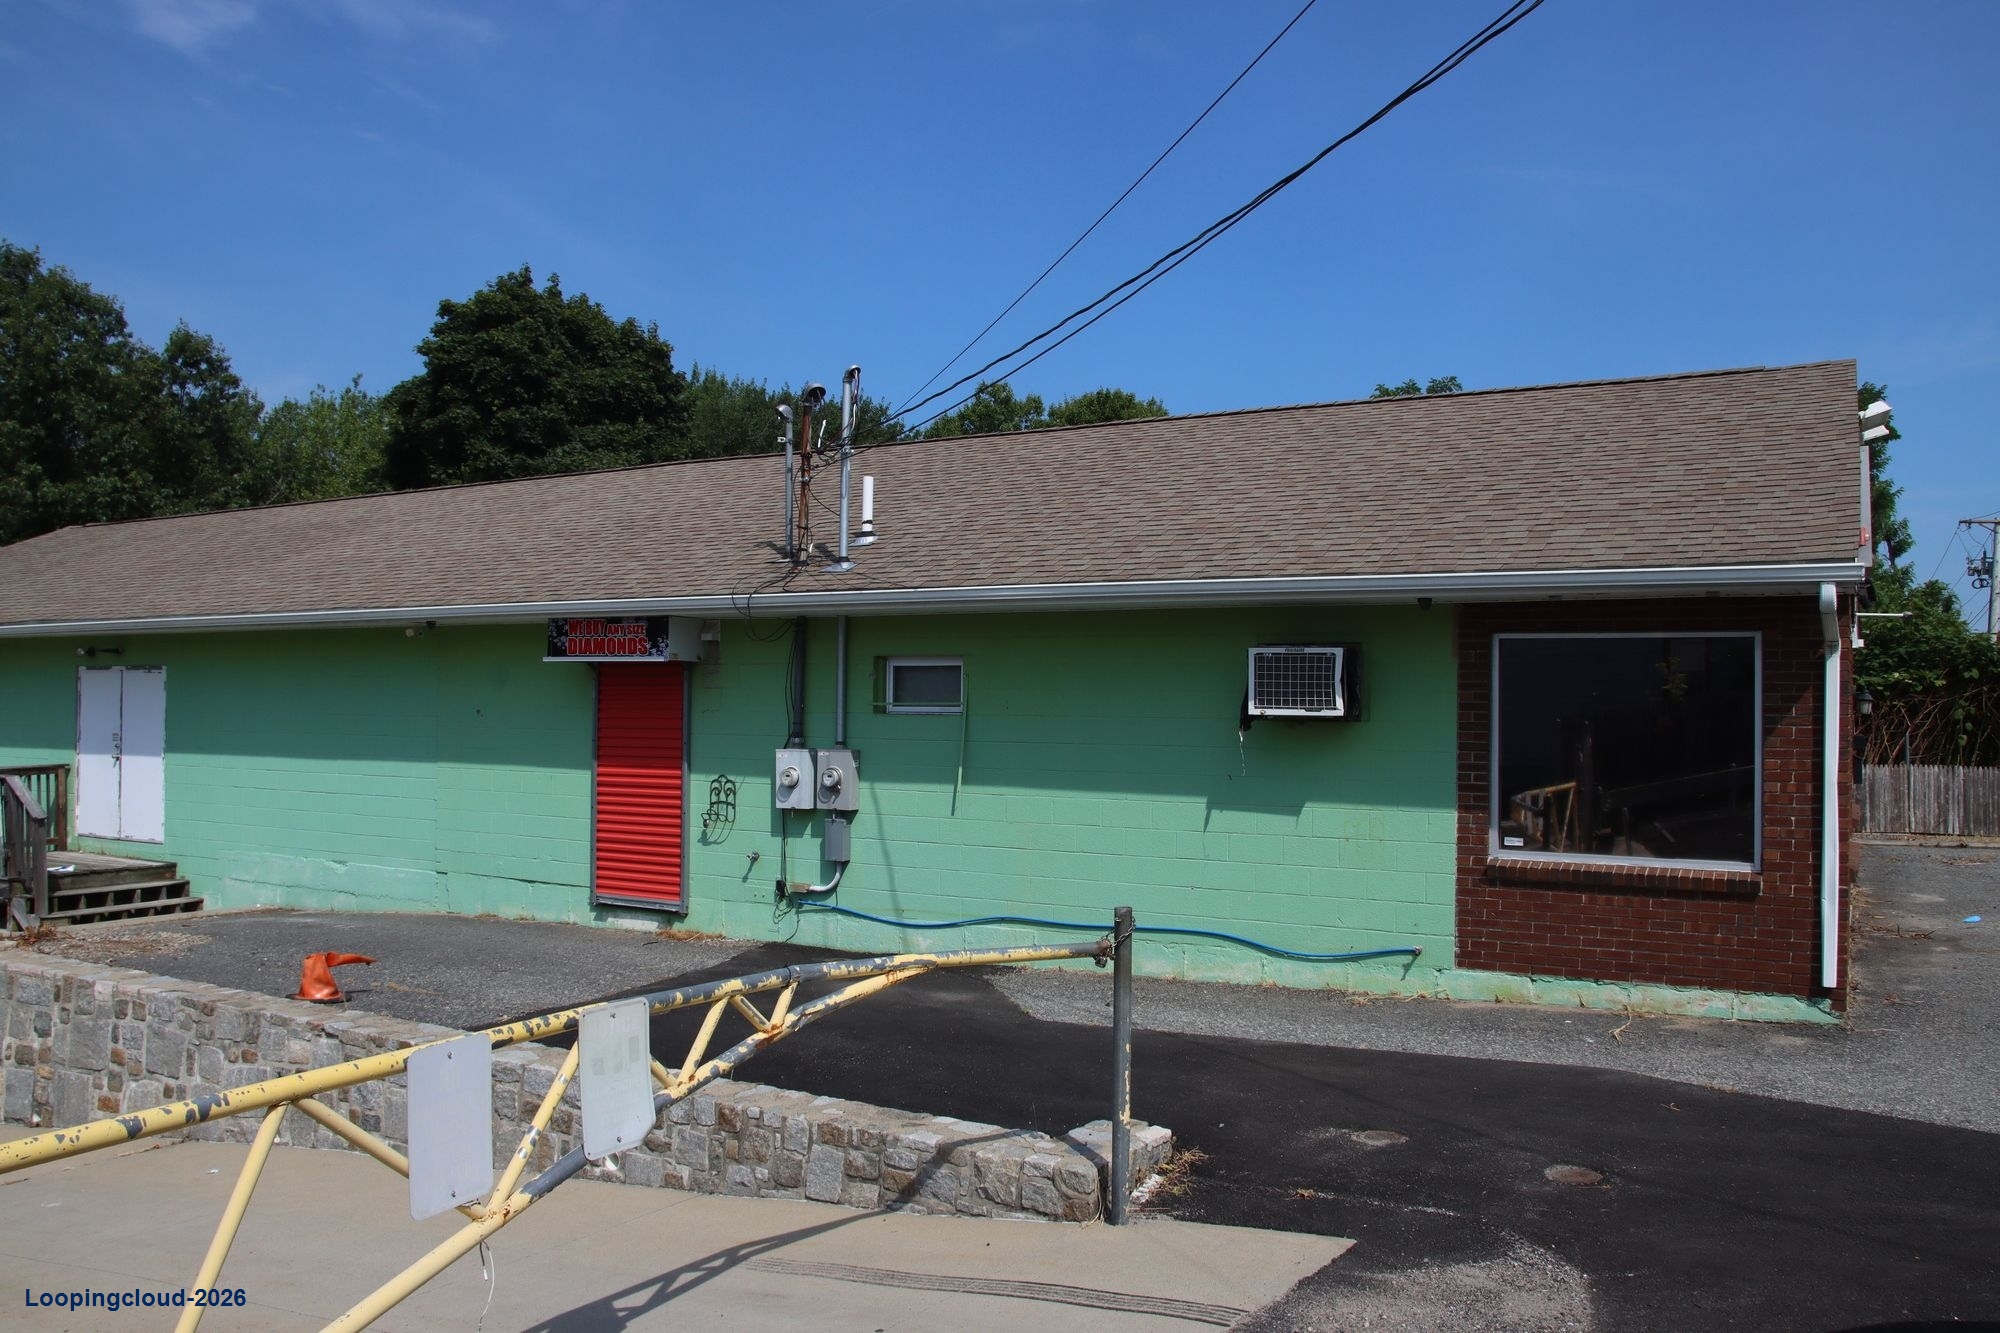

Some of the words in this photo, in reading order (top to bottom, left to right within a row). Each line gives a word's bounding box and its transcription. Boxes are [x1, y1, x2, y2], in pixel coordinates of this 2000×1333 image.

[567, 619, 584, 636] WE
[585, 619, 606, 636] BUY
[606, 624, 625, 636] ANY
[626, 624, 647, 636] SIZE
[567, 637, 649, 656] DIAMONDS
